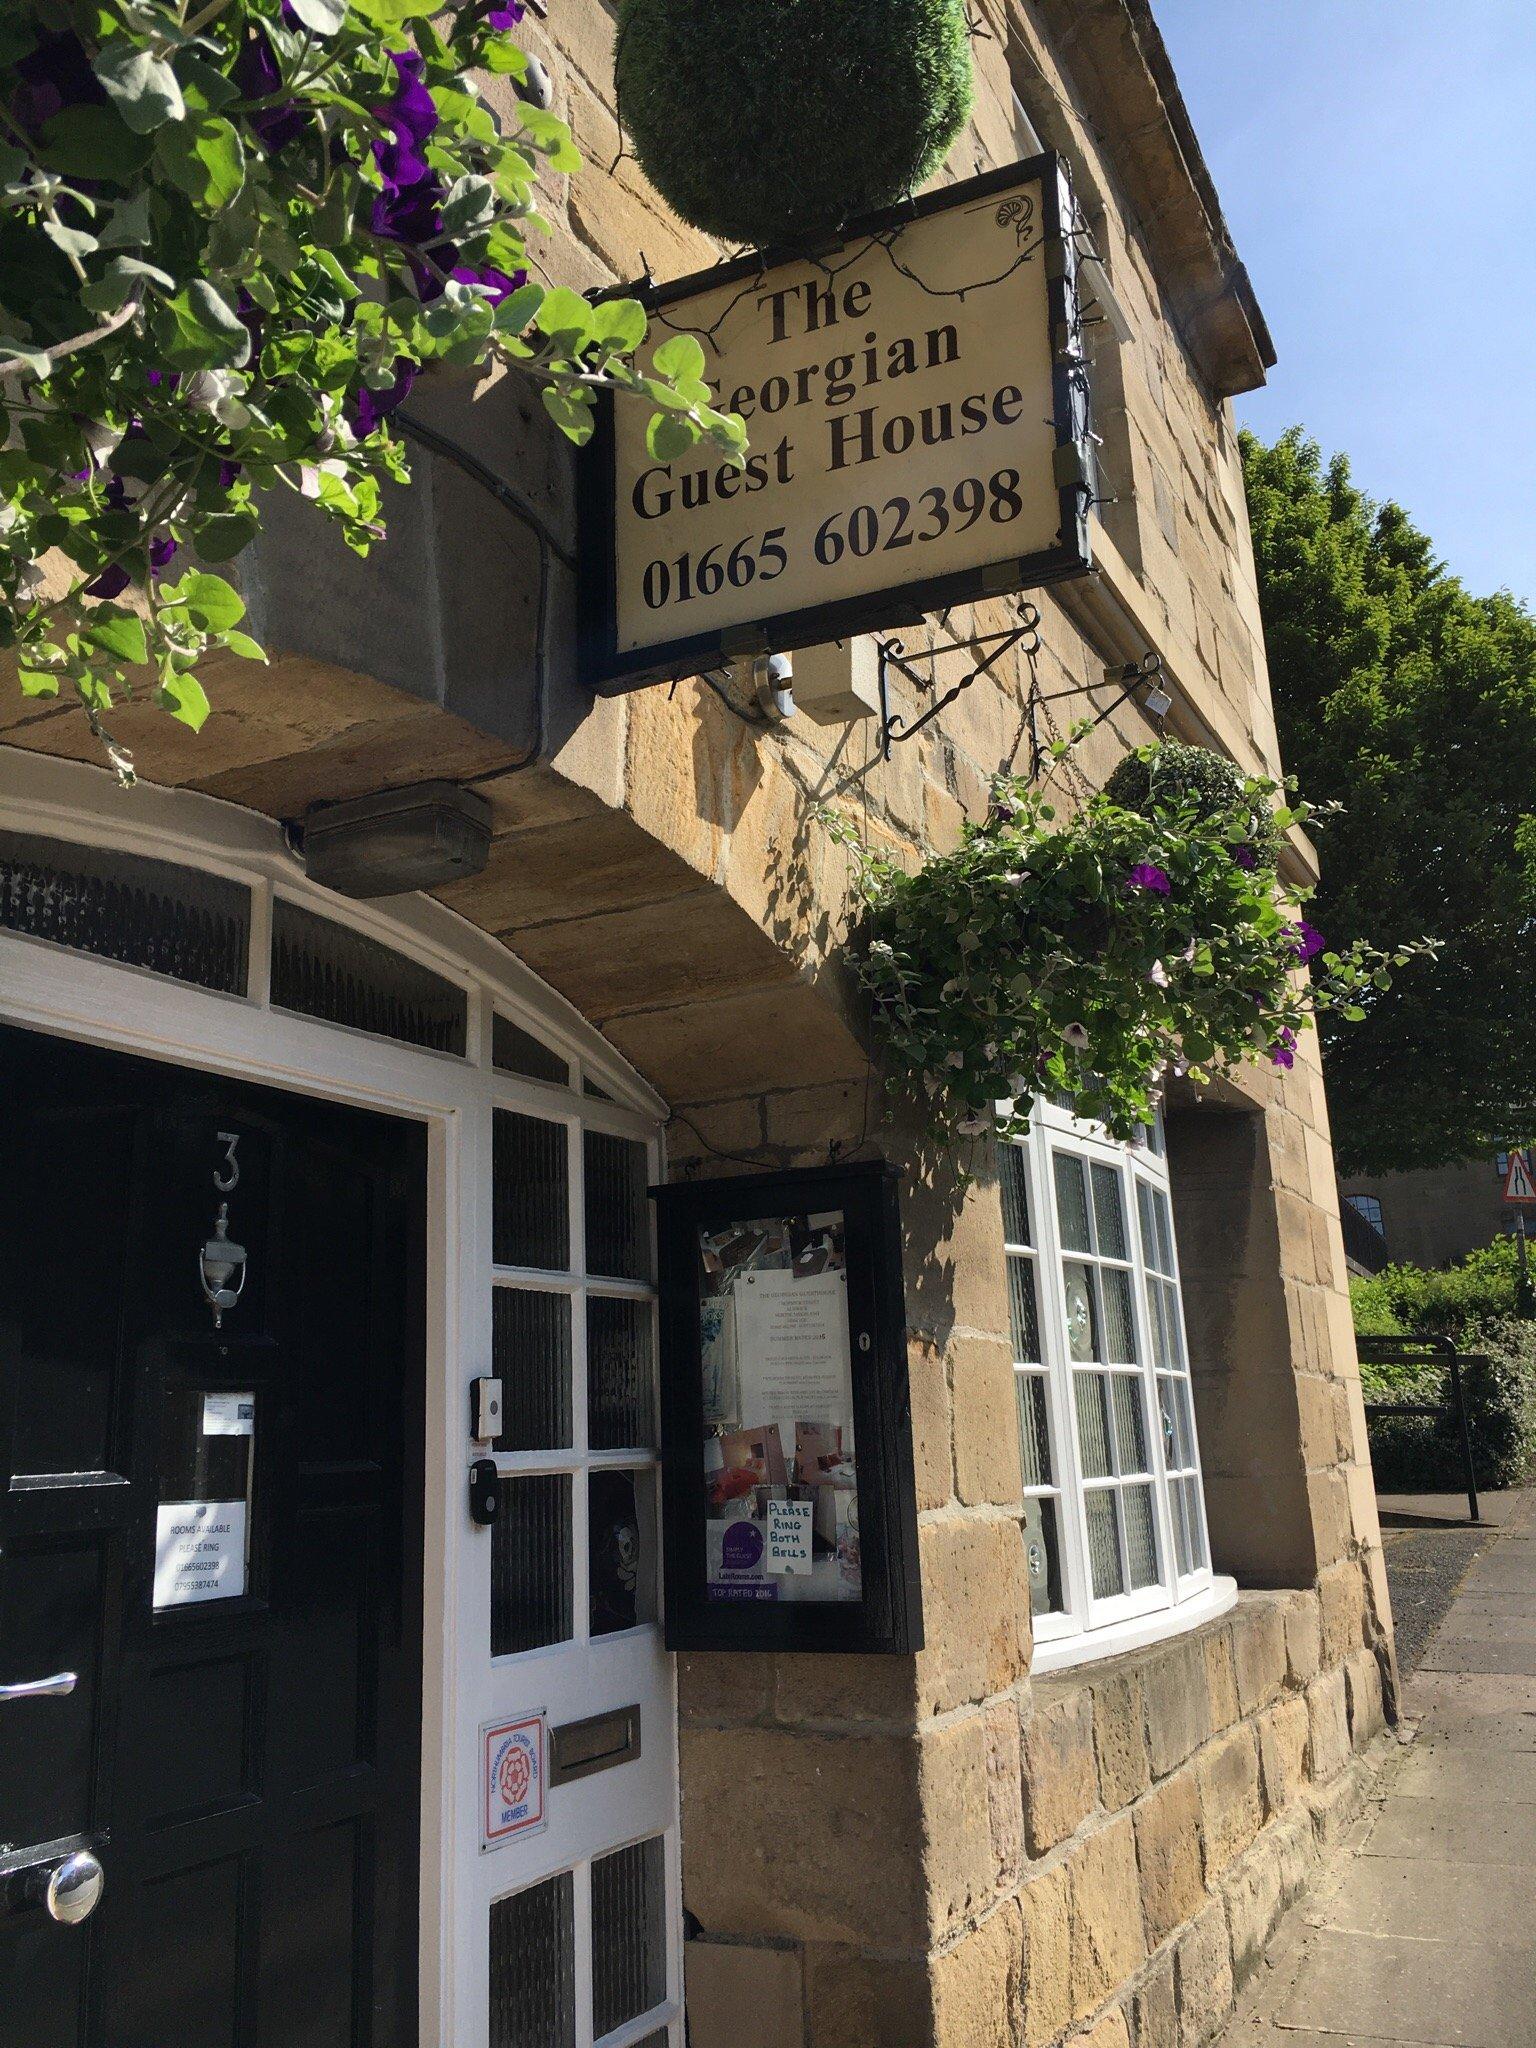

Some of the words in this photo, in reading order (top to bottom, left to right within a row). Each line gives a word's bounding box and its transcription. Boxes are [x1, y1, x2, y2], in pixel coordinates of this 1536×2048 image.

[757, 278, 872, 345] The
[632, 436, 796, 520] Guest
[825, 384, 1024, 473] House
[642, 526, 788, 608] 01665
[814, 468, 1024, 565] 602398
[213, 1131, 240, 1192] 3
[768, 1502, 811, 1517] PLEASE
[170, 1525, 196, 1534] ROOMS
[196, 1524, 231, 1534] AVAILABLE
[774, 1518, 802, 1530] RING
[770, 1531, 800, 1543] BOTH
[178, 1543, 202, 1552] PLEASE
[202, 1543, 220, 1552] RING
[772, 1546, 807, 1558] BELLS
[175, 1561, 220, 1572] 01665602398
[718, 1573, 764, 1581] LateRooms.com
[712, 1589, 727, 1597] TOP
[728, 1588, 753, 1597] RATED
[501, 1804, 528, 1823] MEMBER
